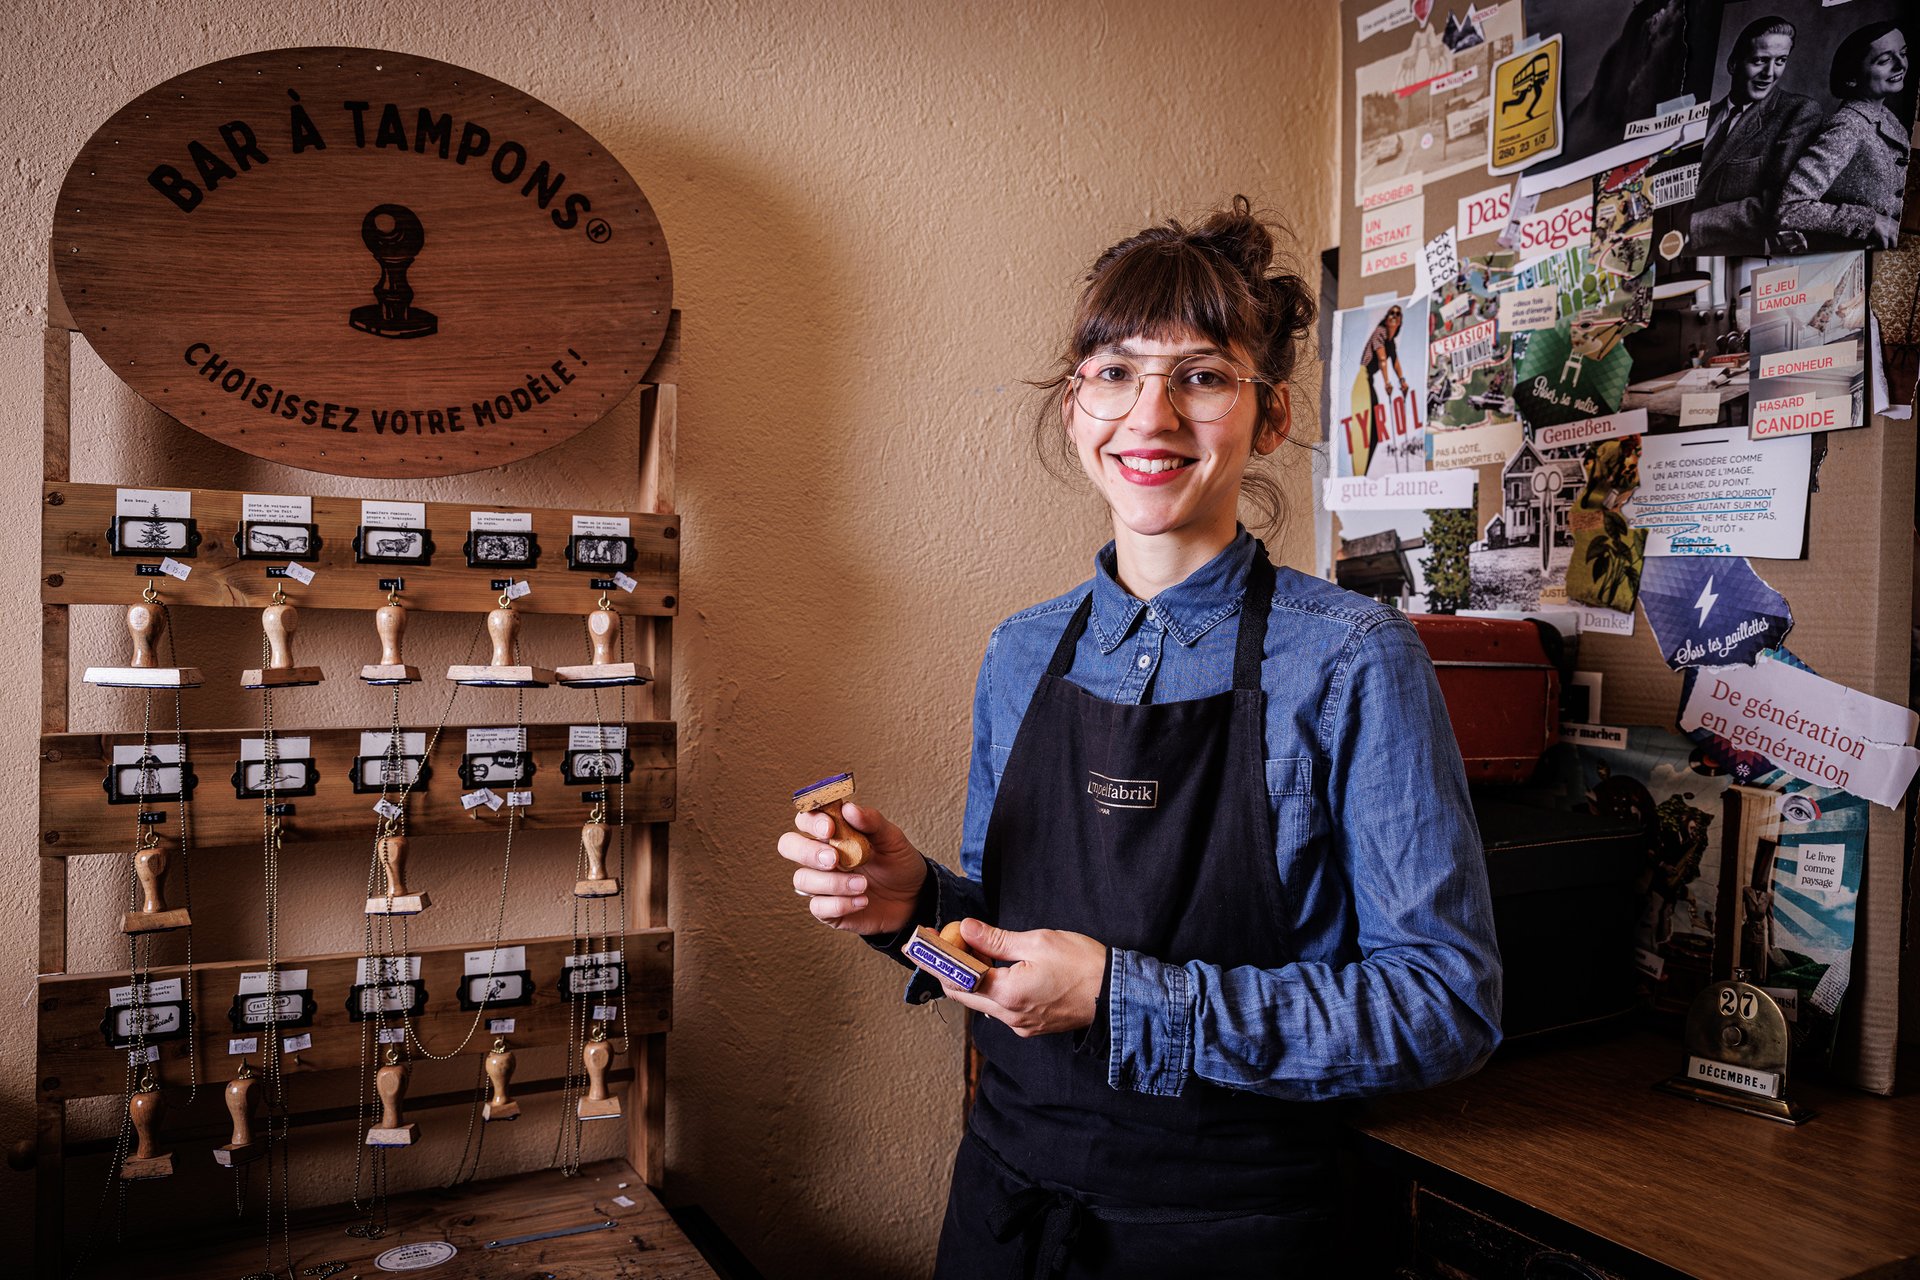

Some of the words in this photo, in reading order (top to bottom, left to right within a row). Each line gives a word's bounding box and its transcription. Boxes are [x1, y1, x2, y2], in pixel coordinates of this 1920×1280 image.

[1627, 122, 1650, 136] Das
[1653, 113, 1684, 130] wilde
[147, 120, 270, 214] BAR
[287, 88, 327, 154] À
[1655, 172, 1684, 188] COMME
[1467, 192, 1511, 234] pas
[1365, 219, 1381, 234] UN
[1365, 224, 1412, 249] INSTANT
[1375, 252, 1407, 270] POILS
[1759, 283, 1772, 296] LE
[1774, 279, 1795, 294] JEU
[1759, 293, 1806, 312] L'AMOUR
[1761, 365, 1775, 377] LE
[1777, 357, 1833, 375] BONHEUR
[184, 343, 360, 433] CHOISISSEZ
[371, 407, 466, 435] VOTRE
[472, 360, 577, 428] MODÈLE
[1688, 408, 1719, 417] encrage
[1759, 397, 1804, 412] HASARD
[1340, 390, 1423, 455] TYROL
[1756, 410, 1835, 435] CANDIDE
[1543, 418, 1617, 445] Genießen.
[1435, 448, 1450, 456] PAS
[1435, 460, 1450, 468] PAS
[1653, 461, 1663, 469] JE
[1665, 460, 1677, 468] ME
[1679, 456, 1727, 468] CONSIDÈRE
[1729, 454, 1763, 465] COMME
[1652, 472, 1665, 480] UN
[1667, 469, 1703, 479] ARTISAN
[1704, 469, 1716, 477] DE
[1341, 478, 1378, 503] gute
[1384, 477, 1443, 496] Laune.
[1655, 483, 1667, 491] DE
[1669, 482, 1679, 490] LA
[1708, 479, 1720, 487] DU
[1650, 493, 1686, 501] PROPRES
[1687, 492, 1710, 500] MOTS
[1711, 491, 1723, 499] NE
[1726, 488, 1777, 498] POURRONT
[1636, 505, 1662, 514] JAMAIS
[1664, 504, 1675, 512] EN
[1676, 503, 1694, 512] DIRE
[1697, 502, 1731, 511] AUTANT
[1733, 501, 1750, 509] SUR
[1754, 500, 1771, 509] MOI
[1645, 516, 1663, 525] MON
[1701, 514, 1713, 522] NE
[1715, 513, 1728, 522] ME
[1730, 513, 1755, 521] LISEZ
[1652, 526, 1671, 535] MAIS
[1672, 526, 1699, 534] VOYEZ
[1702, 524, 1736, 533] PLUTÔT
[1584, 613, 1630, 629] Danke!
[1719, 617, 1769, 658] paillettes
[1710, 679, 1742, 706] De
[1742, 698, 1866, 760] génération
[1580, 728, 1621, 742] machen
[1700, 711, 1728, 734] en
[1730, 723, 1850, 788] génération
[1805, 851, 1816, 860] Le
[1817, 851, 1836, 863] livre
[1803, 864, 1835, 875] comme
[1801, 875, 1833, 888] paysage
[1721, 990, 1754, 1016] 27
[1699, 1064, 1758, 1088] DÉCEMBRE
